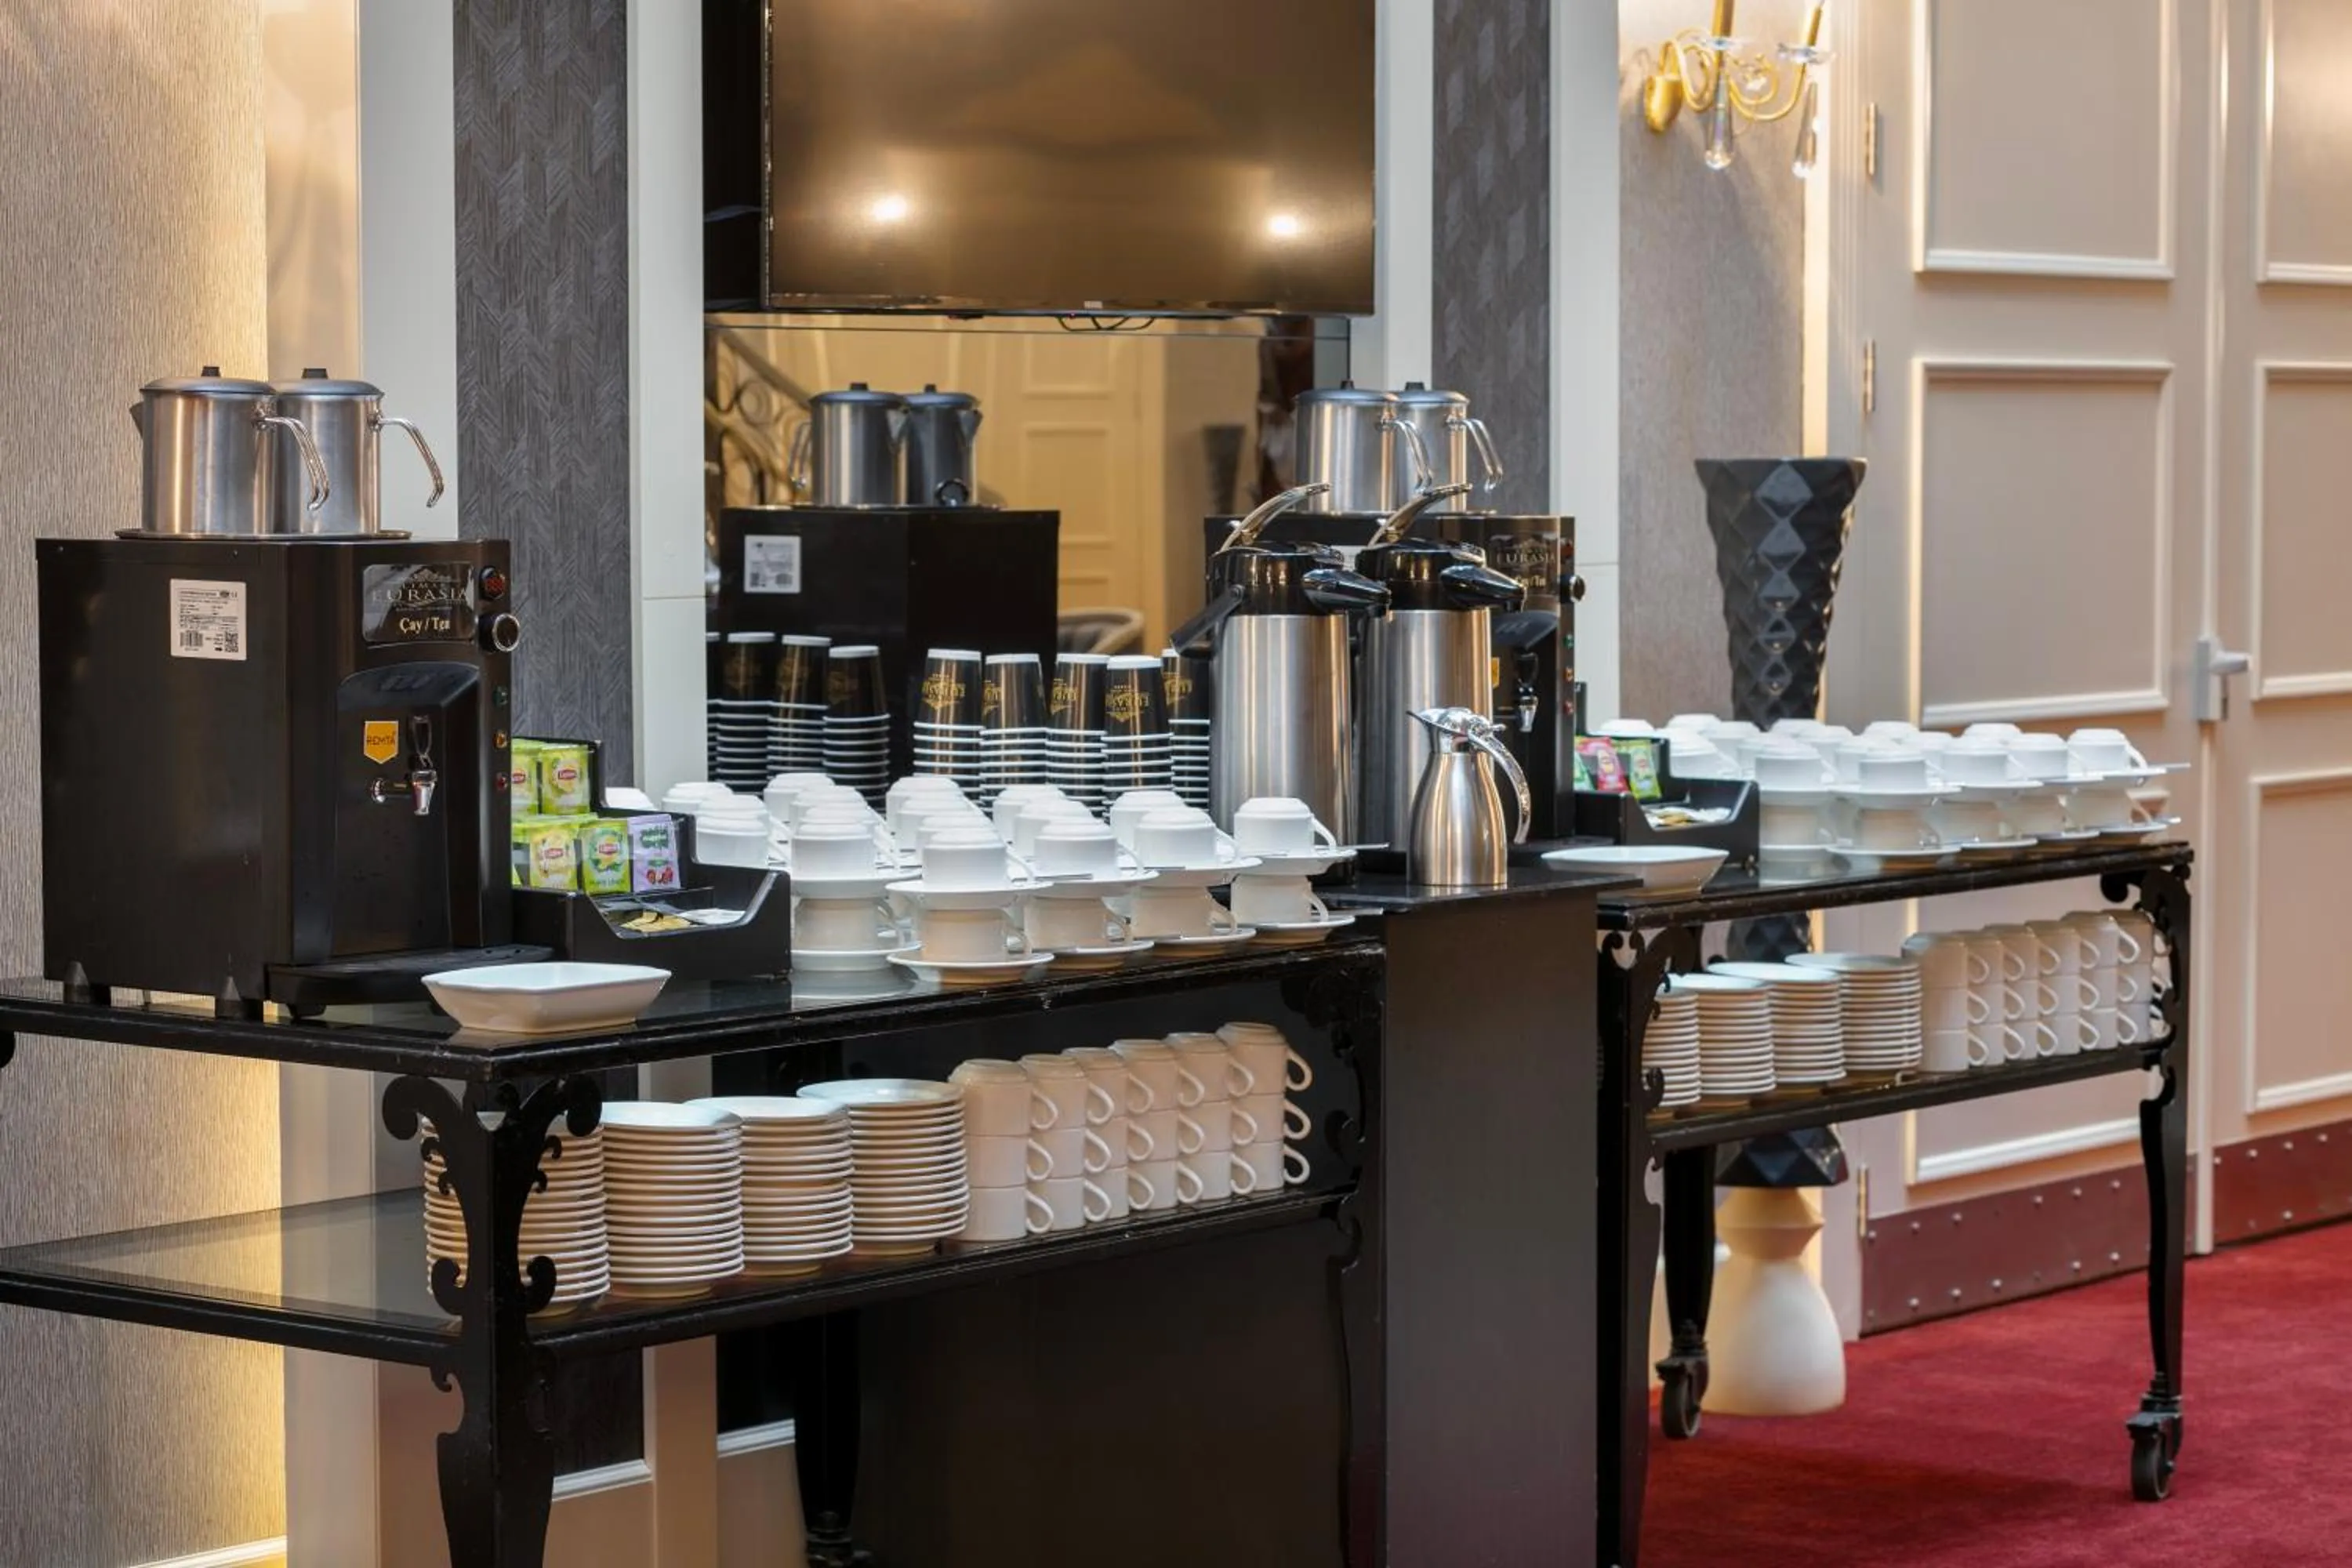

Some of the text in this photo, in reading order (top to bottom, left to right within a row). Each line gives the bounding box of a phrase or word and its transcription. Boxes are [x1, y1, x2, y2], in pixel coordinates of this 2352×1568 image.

[372, 587, 467, 602] EURASIA
[399, 617, 423, 634] Çay
[431, 616, 451, 630] Tea
